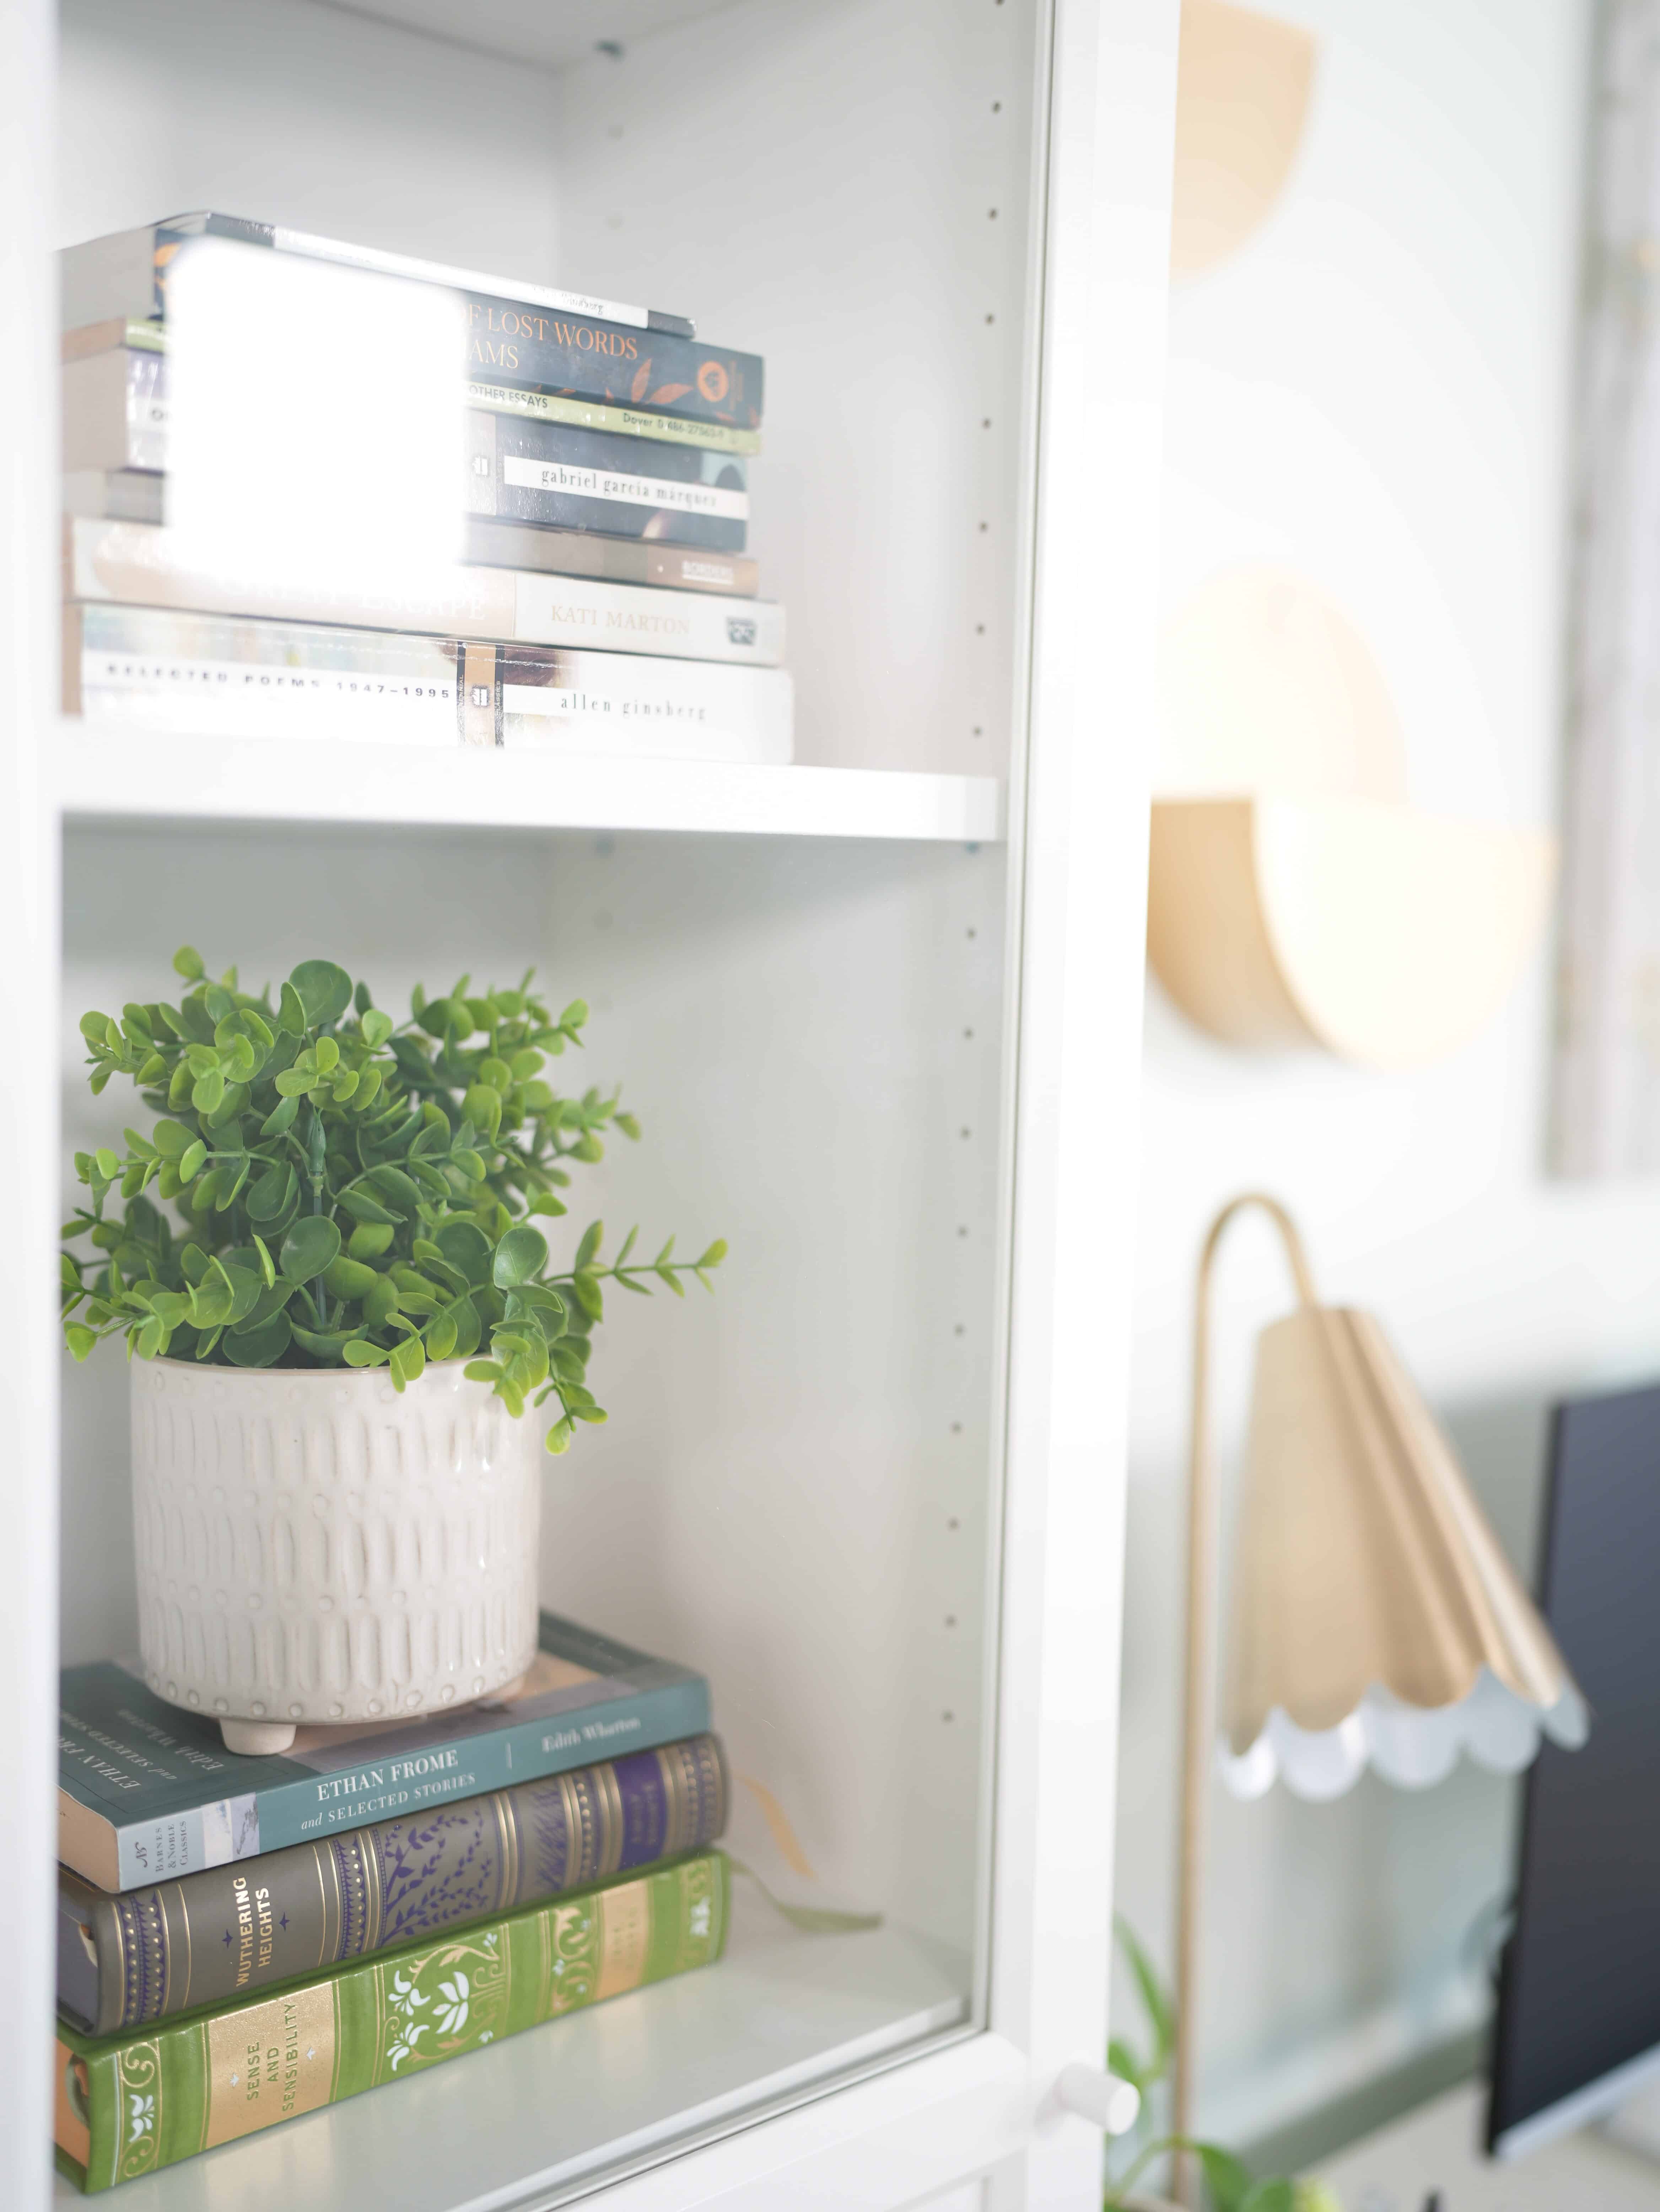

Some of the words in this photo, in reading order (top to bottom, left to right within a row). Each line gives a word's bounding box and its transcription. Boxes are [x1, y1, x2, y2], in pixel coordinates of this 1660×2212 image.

[488, 307, 549, 341] LOST
[554, 322, 638, 360] WORDS
[468, 338, 519, 369] AMS
[469, 385, 505, 401] OTHER
[509, 392, 548, 408] ESSAYS
[623, 412, 652, 427] Dover
[541, 467, 597, 487] gabriel
[551, 605, 598, 626] KATI
[605, 611, 690, 634] MARTON
[245, 674, 319, 688] POEMS
[561, 693, 610, 712] allen
[622, 699, 706, 720] ginsberg
[541, 1728, 582, 1753] Edith
[77, 1755, 142, 1789] ETHAN
[147, 1768, 177, 1779] and
[174, 1746, 225, 1771] Edith
[317, 1768, 384, 1801] ETHAN
[390, 1749, 458, 1782] FROME
[301, 1812, 323, 1830] and
[328, 1790, 409, 1822] SELECTED
[414, 1772, 476, 1800] STORIES
[155, 1827, 164, 1872] BARNES
[180, 1821, 188, 1865] CLASSICS
[233, 1877, 253, 1987] WUTHERING
[255, 1888, 273, 1967] HEIGHTS
[247, 2041, 260, 2100] SENSE
[267, 2047, 279, 2082] AND
[282, 2003, 298, 2111] SENSIBILITY
